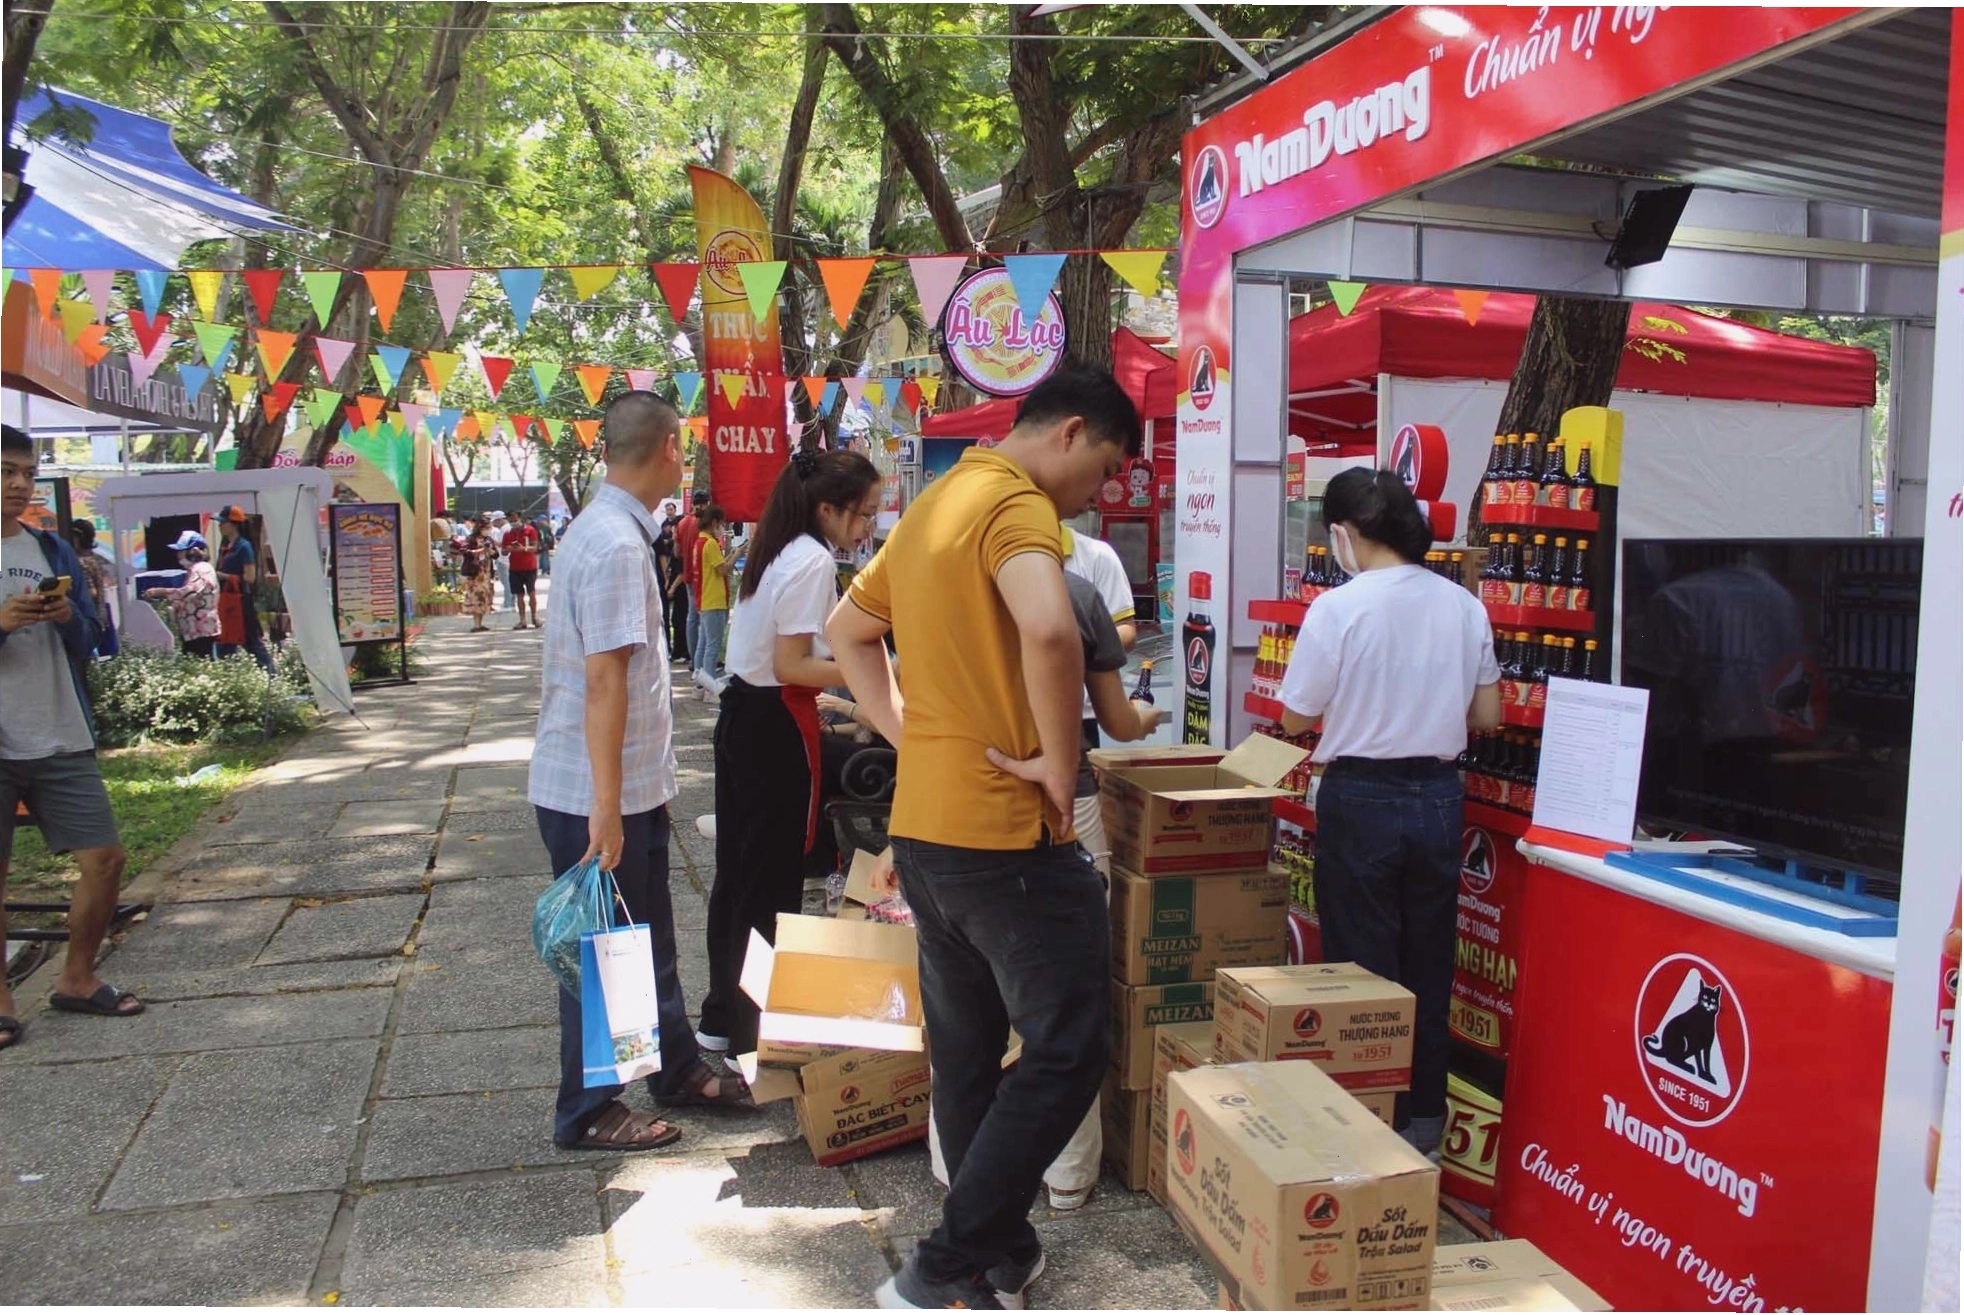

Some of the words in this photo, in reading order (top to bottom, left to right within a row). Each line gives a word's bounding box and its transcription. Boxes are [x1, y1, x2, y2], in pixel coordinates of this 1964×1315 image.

[1464, 6, 1561, 98] Chuẩn
[1571, 7, 1601, 60] vị
[948, 296, 994, 346] Âu
[1004, 307, 1065, 356] Lạc
[715, 425, 776, 454] CHAY
[1186, 492, 1215, 518] ngon
[1457, 893, 1501, 923] amDương
[1144, 938, 1199, 952] MEIZAN
[1472, 920, 1499, 944] TƯƠNG
[1149, 1007, 1213, 1023] MEIZAN
[1457, 1006, 1492, 1041] 1951
[1338, 1027, 1380, 1043] THƯỢNG
[1381, 1024, 1410, 1041] HẠNG
[1364, 1046, 1392, 1059] 1951
[1658, 1077, 1686, 1103] SINCE
[1688, 1092, 1711, 1113] 1951
[1602, 1094, 1758, 1217] NamDương
[1382, 1204, 1408, 1223] Sốt
[1392, 1219, 1429, 1241] Dấm
[1520, 1143, 1585, 1205] Chuẩn
[1588, 1192, 1613, 1225] vị
[1612, 1207, 1672, 1260] ngon
[1676, 1243, 1766, 1313] truyền
[1387, 1242, 1423, 1256] Salad
